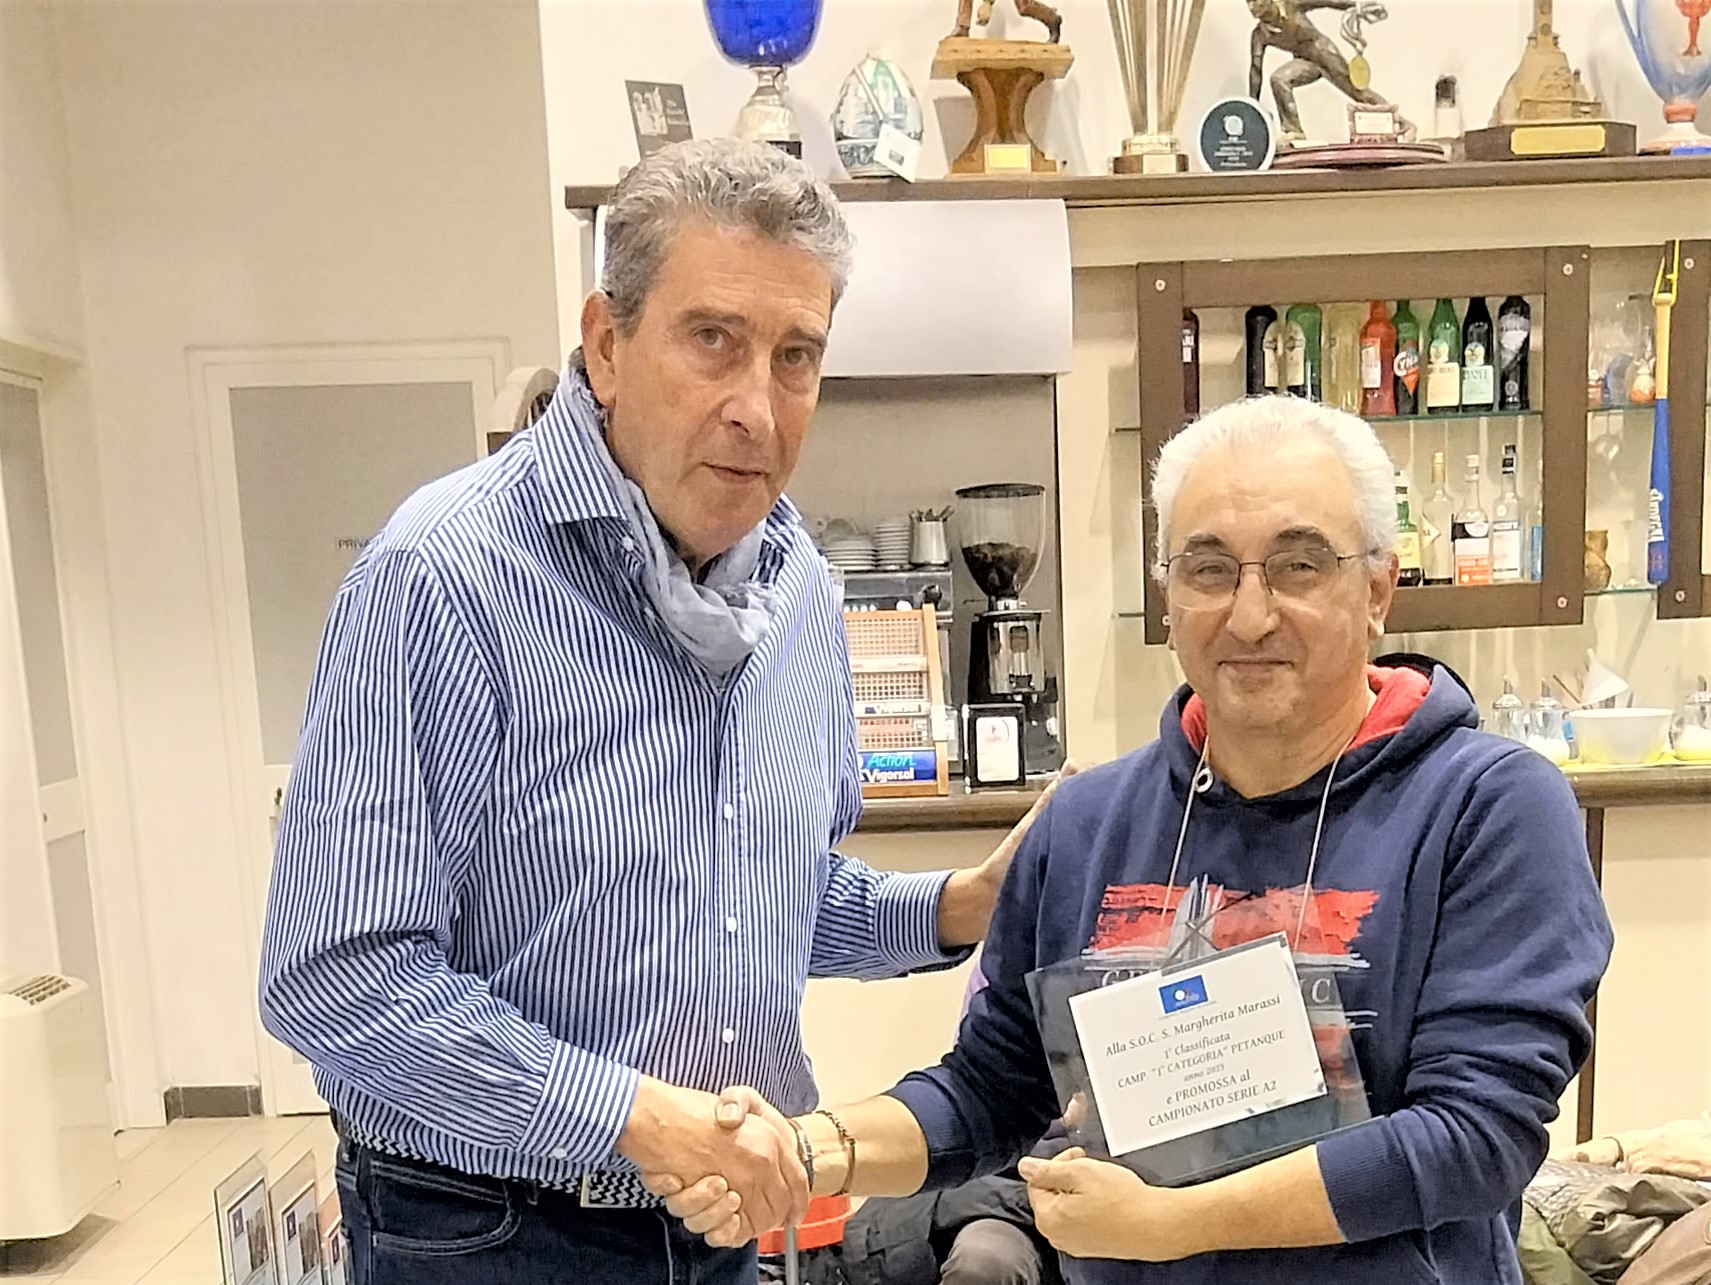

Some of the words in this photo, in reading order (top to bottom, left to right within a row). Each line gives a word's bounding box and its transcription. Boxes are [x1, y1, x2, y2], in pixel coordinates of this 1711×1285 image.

[1106, 1042, 1127, 1057] Alla
[1161, 1028, 1171, 1040] S.
[1173, 1009, 1235, 1036] Margherita
[1237, 994, 1281, 1016] Marassi
[1174, 1033, 1231, 1056] Classificata
[1231, 1029, 1285, 1055] PETANQUE
[1166, 1096, 1173, 1105] e
[1175, 1075, 1237, 1102] PROMOSSA
[1239, 1068, 1251, 1083] al
[1183, 1069, 1204, 1082] anno
[1148, 1095, 1225, 1127] CAMPIONATO
[1227, 1084, 1260, 1104] SERIE
[1262, 1080, 1277, 1093] A2
